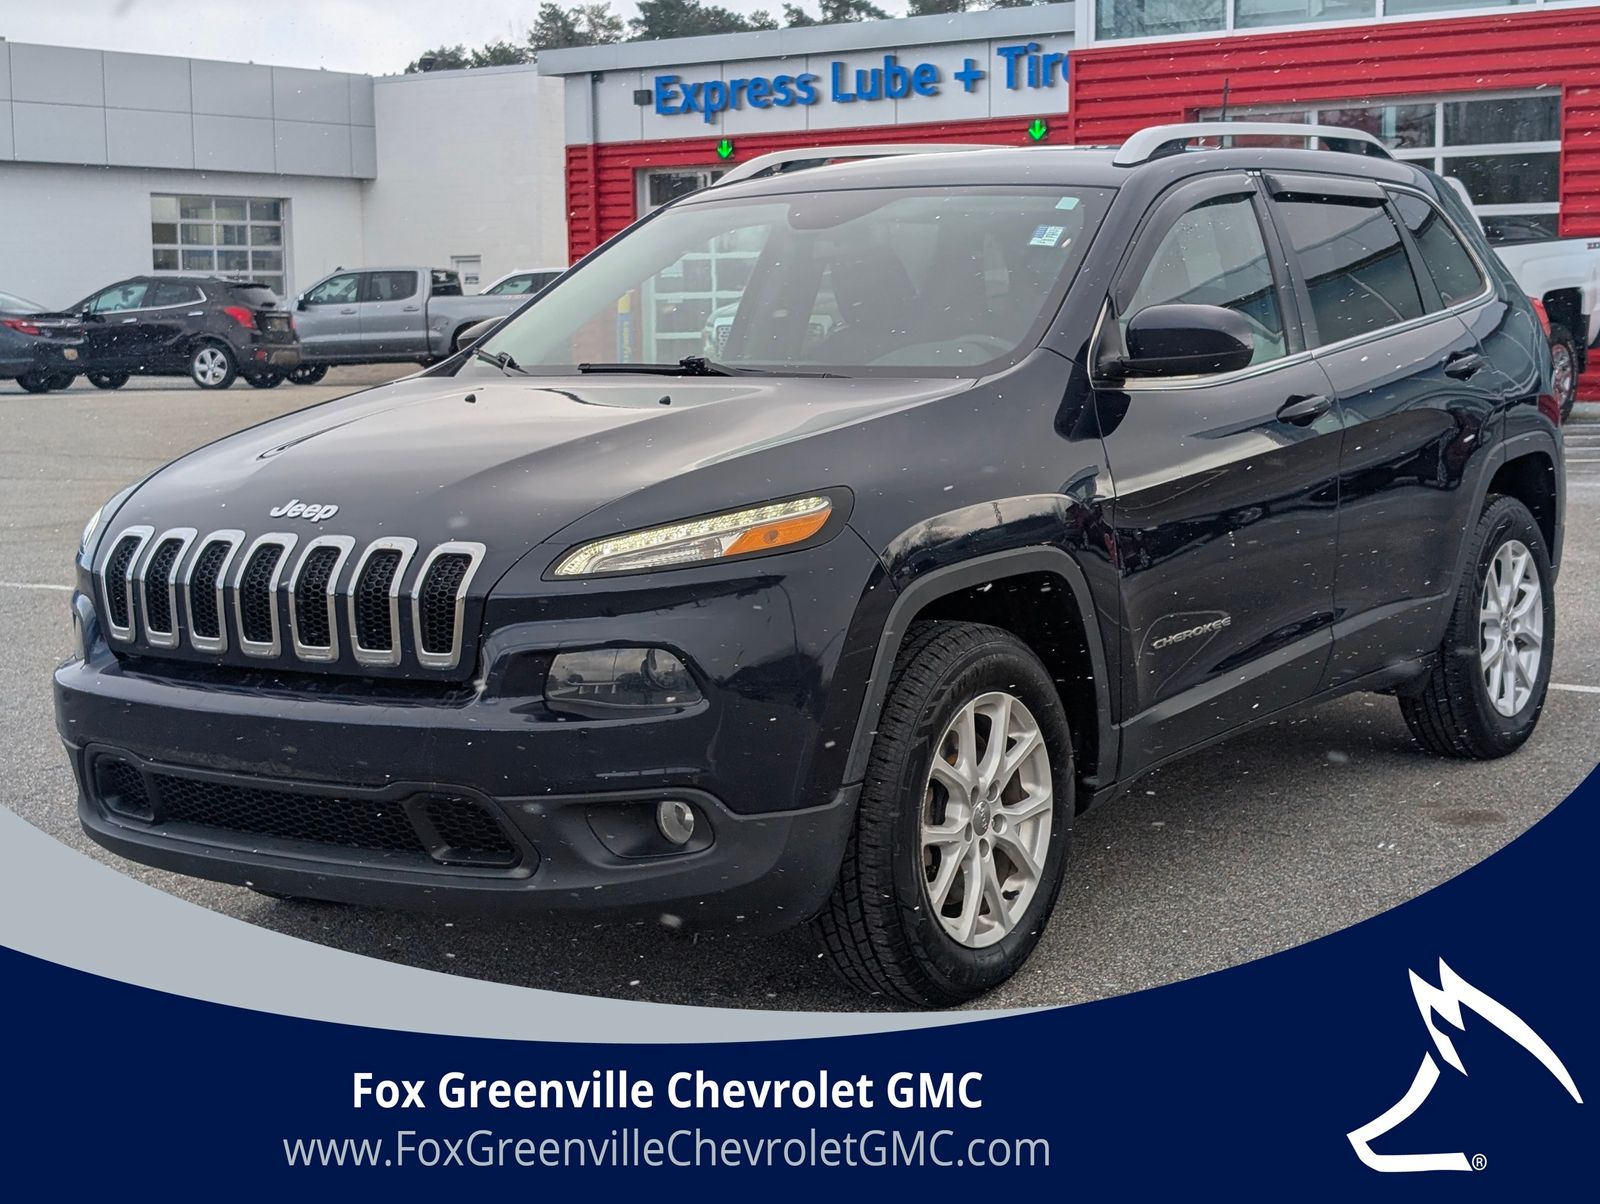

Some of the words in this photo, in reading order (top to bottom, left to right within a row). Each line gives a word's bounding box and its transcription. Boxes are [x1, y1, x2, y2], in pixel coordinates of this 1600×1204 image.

[655, 73, 819, 124] Express
[831, 55, 942, 103] Lube
[270, 499, 339, 522] Jeep
[1152, 616, 1232, 650] CHEROKEE
